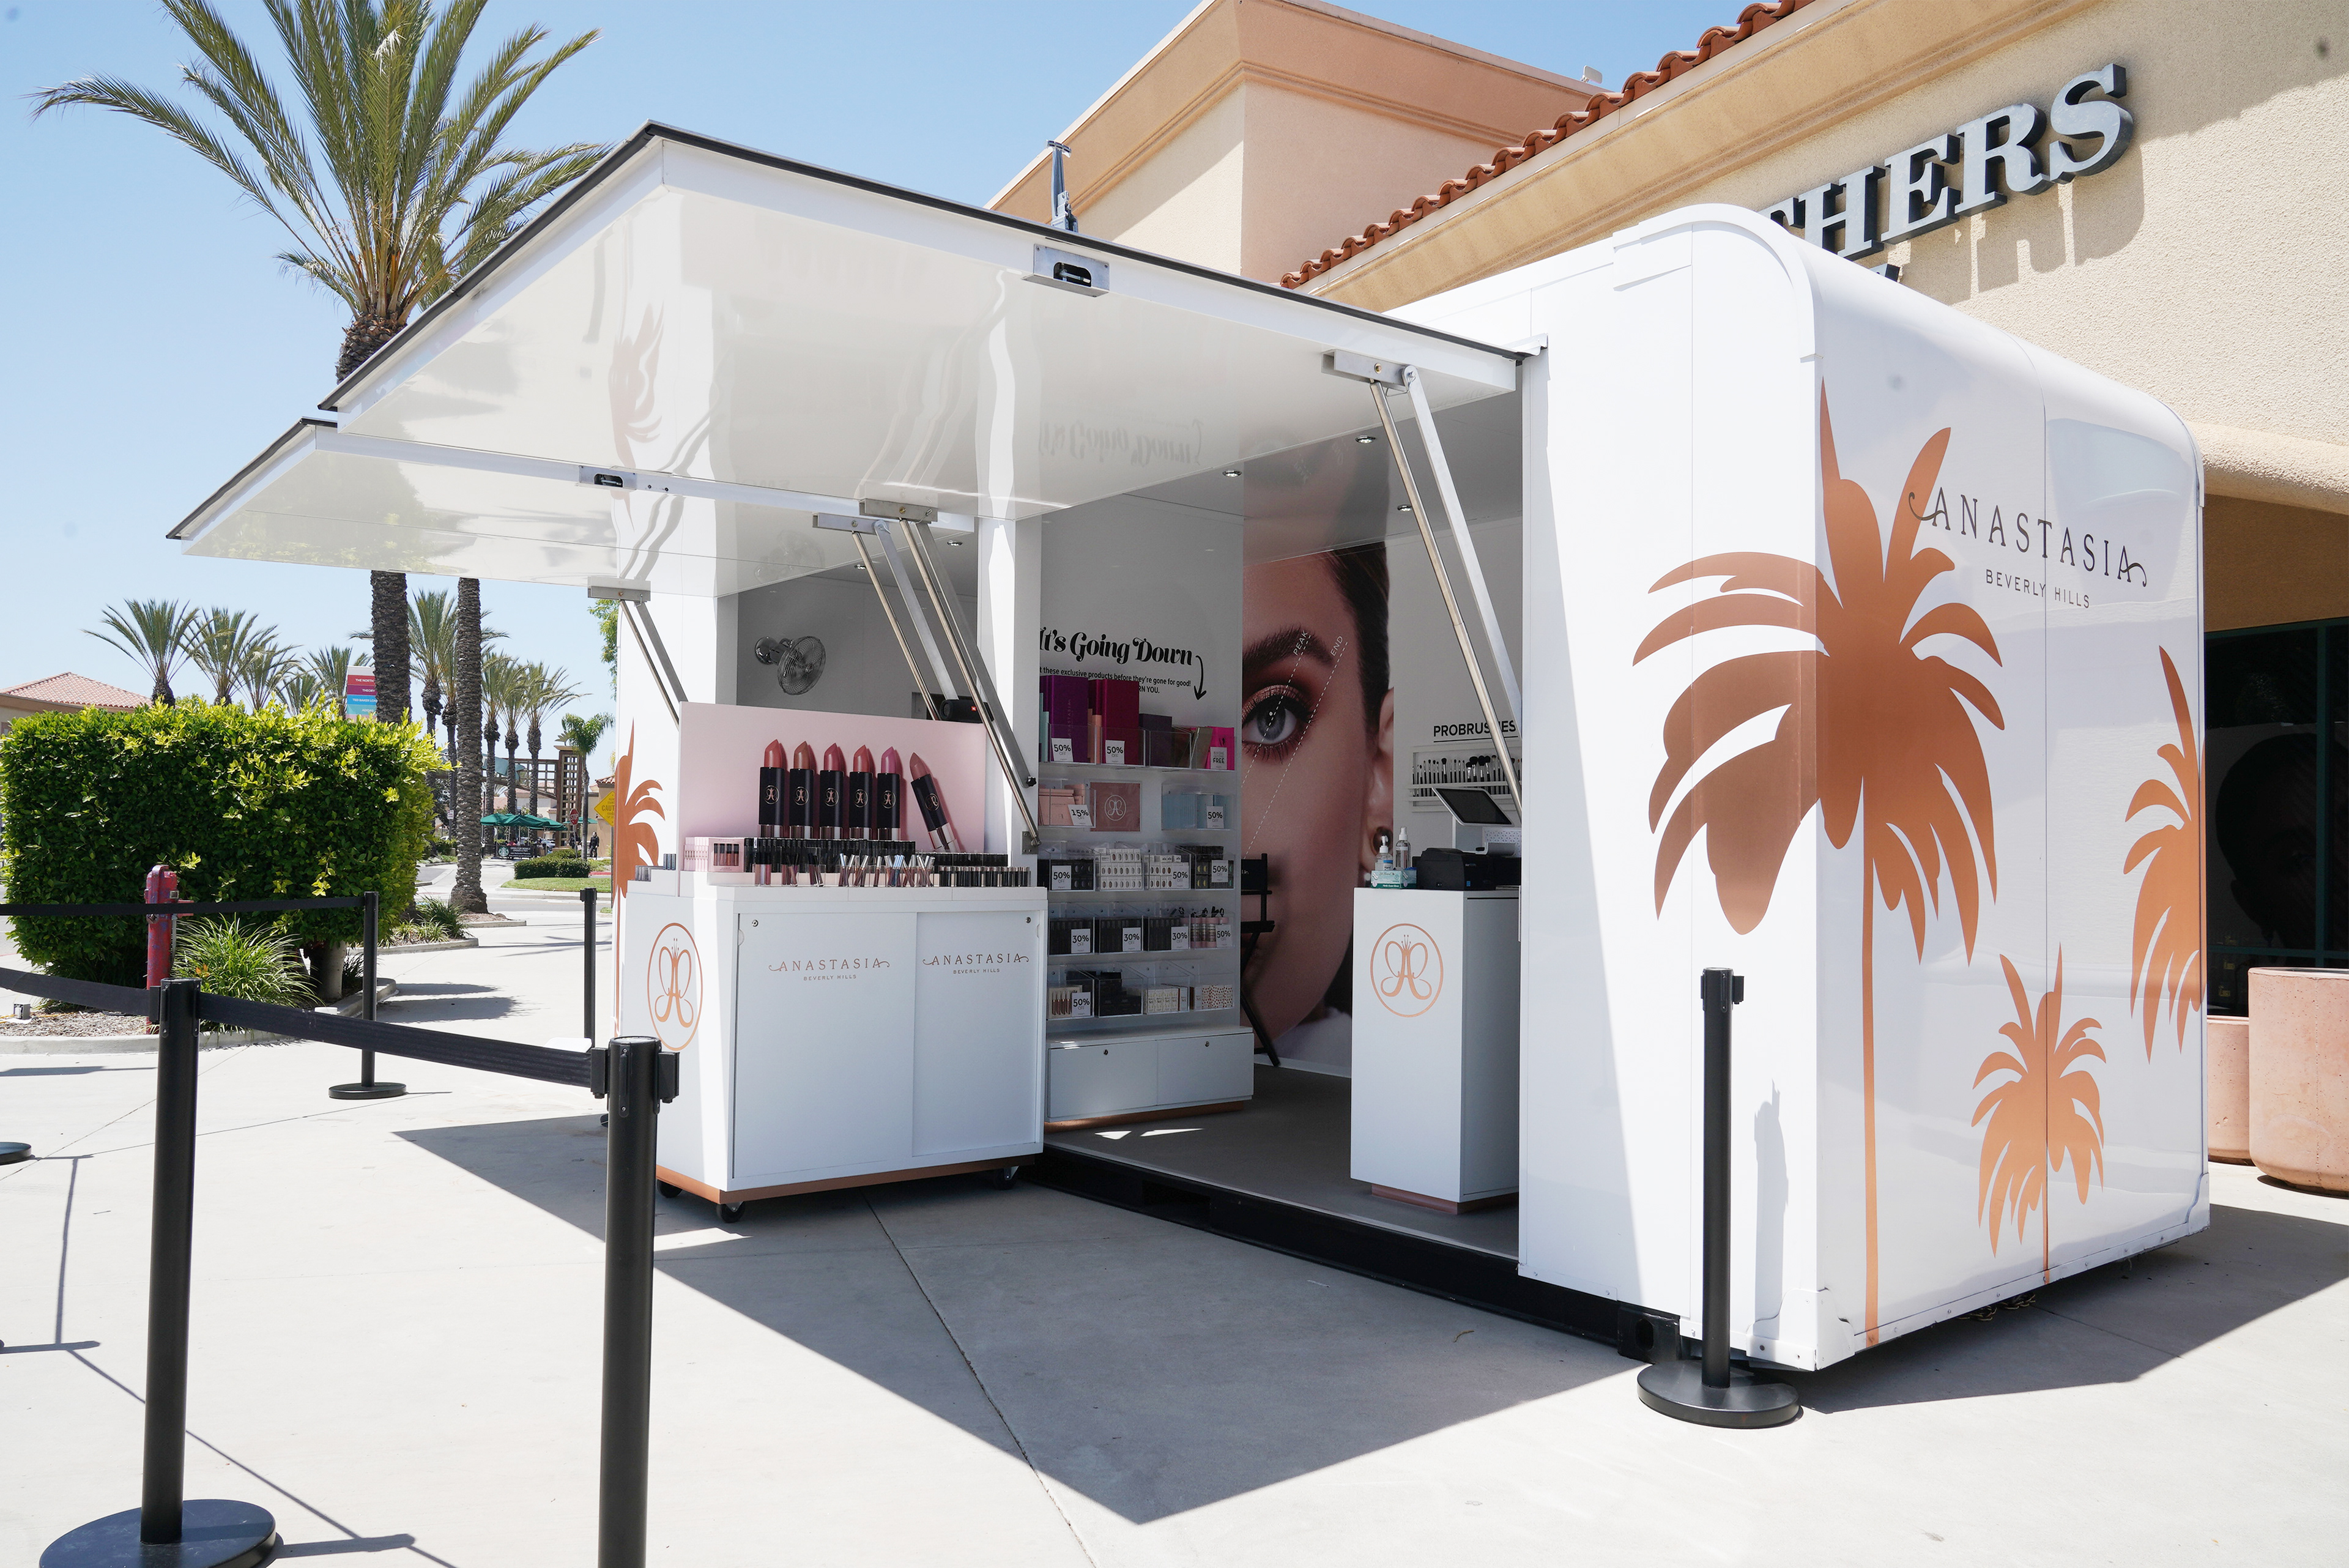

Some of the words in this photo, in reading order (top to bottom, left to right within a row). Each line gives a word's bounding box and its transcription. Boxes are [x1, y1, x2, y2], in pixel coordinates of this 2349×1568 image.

[1909, 487, 2147, 587] ANASTASIA
[1986, 570, 2046, 598] BEVERLY
[2055, 587, 2090, 608] HILLS
[1039, 627, 1066, 652] It's
[1070, 632, 1130, 664] Going
[1132, 637, 1192, 666] Down
[1061, 669, 1087, 677] exclusive
[1433, 720, 1516, 737] PROBRUSES
[768, 958, 890, 972] ANASTASIA
[922, 953, 1030, 965] ANASTASIA
[1074, 998, 1090, 1007] 50%
